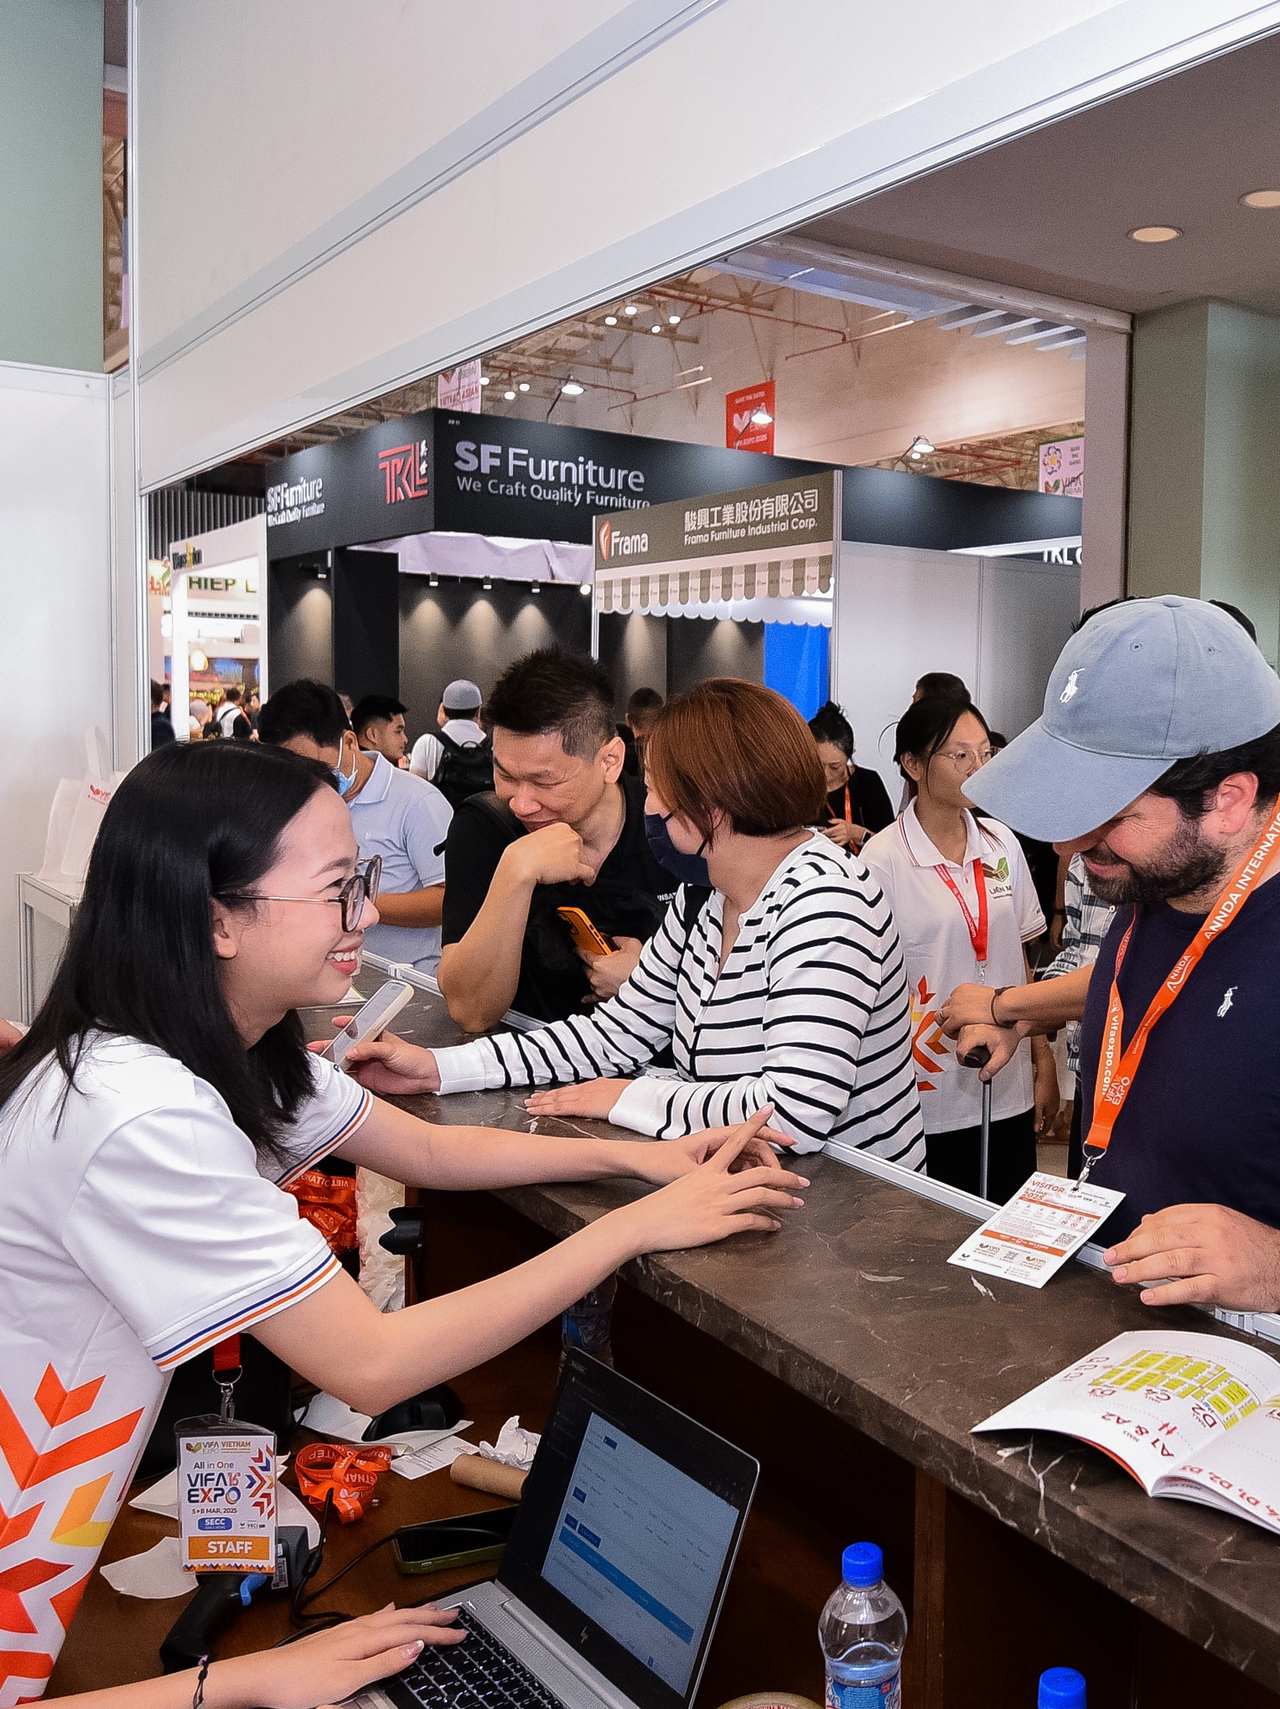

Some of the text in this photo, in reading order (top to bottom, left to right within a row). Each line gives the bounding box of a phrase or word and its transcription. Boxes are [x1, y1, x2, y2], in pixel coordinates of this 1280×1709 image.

[454, 440, 502, 474] SF
[508, 447, 645, 492] Furniture
[456, 475, 650, 509] We Craft Quality Furniture
[684, 517, 818, 546] Frama Furniture Industrial Corp.
[611, 529, 649, 557] Frama
[1204, 893, 1242, 940] ANNDA
[1111, 1076, 1131, 1106] EXPO
[1022, 1191, 1045, 1201] 2025
[1031, 1180, 1066, 1194] VISITOR
[1191, 1403, 1218, 1429] D2
[221, 1440, 251, 1448] VIETNAM
[1101, 1411, 1175, 1459] A1 & A2
[193, 1461, 234, 1470] All in One
[187, 1473, 227, 1487] VIFA
[1208, 1471, 1233, 1491] D2,
[187, 1487, 242, 1505] EXPO
[1237, 1488, 1261, 1508] D1,
[205, 1518, 226, 1526] SECC
[207, 1541, 253, 1554] STAFF
